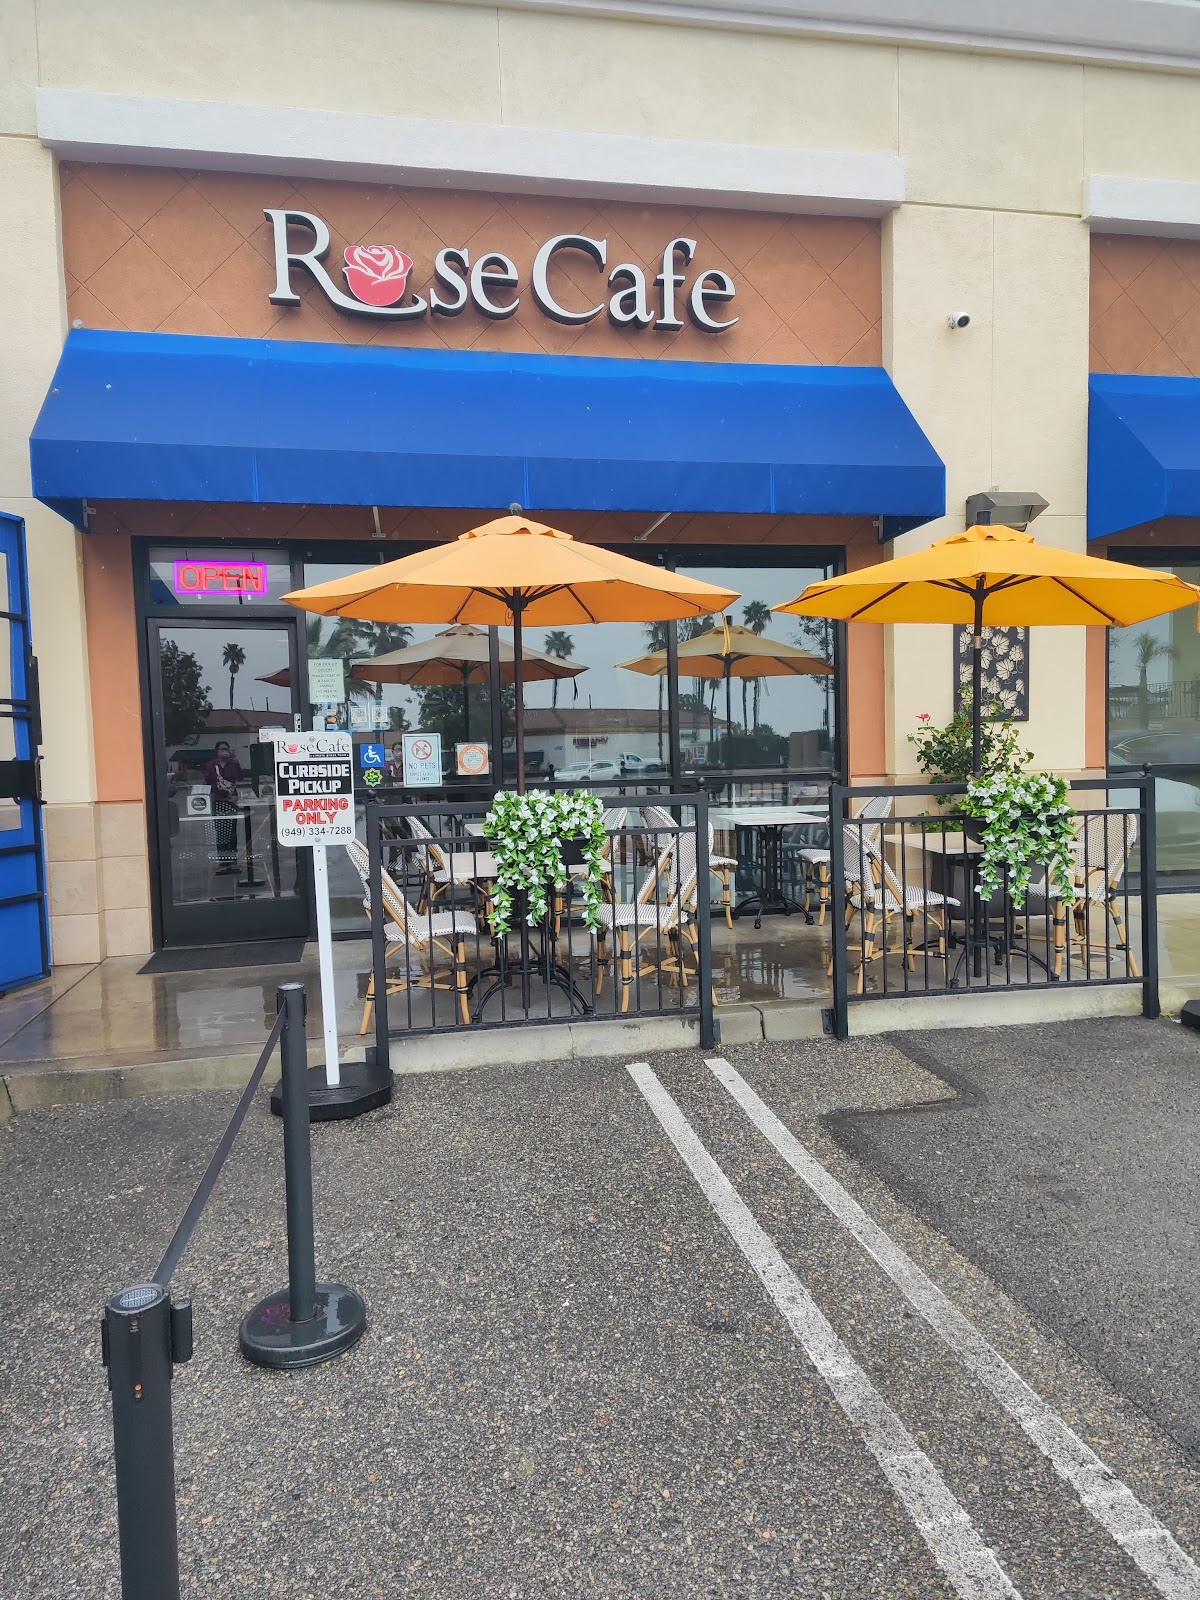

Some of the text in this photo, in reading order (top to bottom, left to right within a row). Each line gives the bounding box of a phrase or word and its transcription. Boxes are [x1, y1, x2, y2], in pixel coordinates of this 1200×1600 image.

[531, 233, 740, 332] Cafe
[179, 564, 263, 592] OPEN
[316, 738, 350, 753] Cafe
[279, 762, 350, 779] CURBSIDE
[408, 761, 436, 770] NO PETS
[288, 779, 342, 794] PICKUP
[282, 797, 349, 812] PARKING
[295, 811, 337, 825] ONLY
[281, 826, 352, 837] (949) 334-7288
